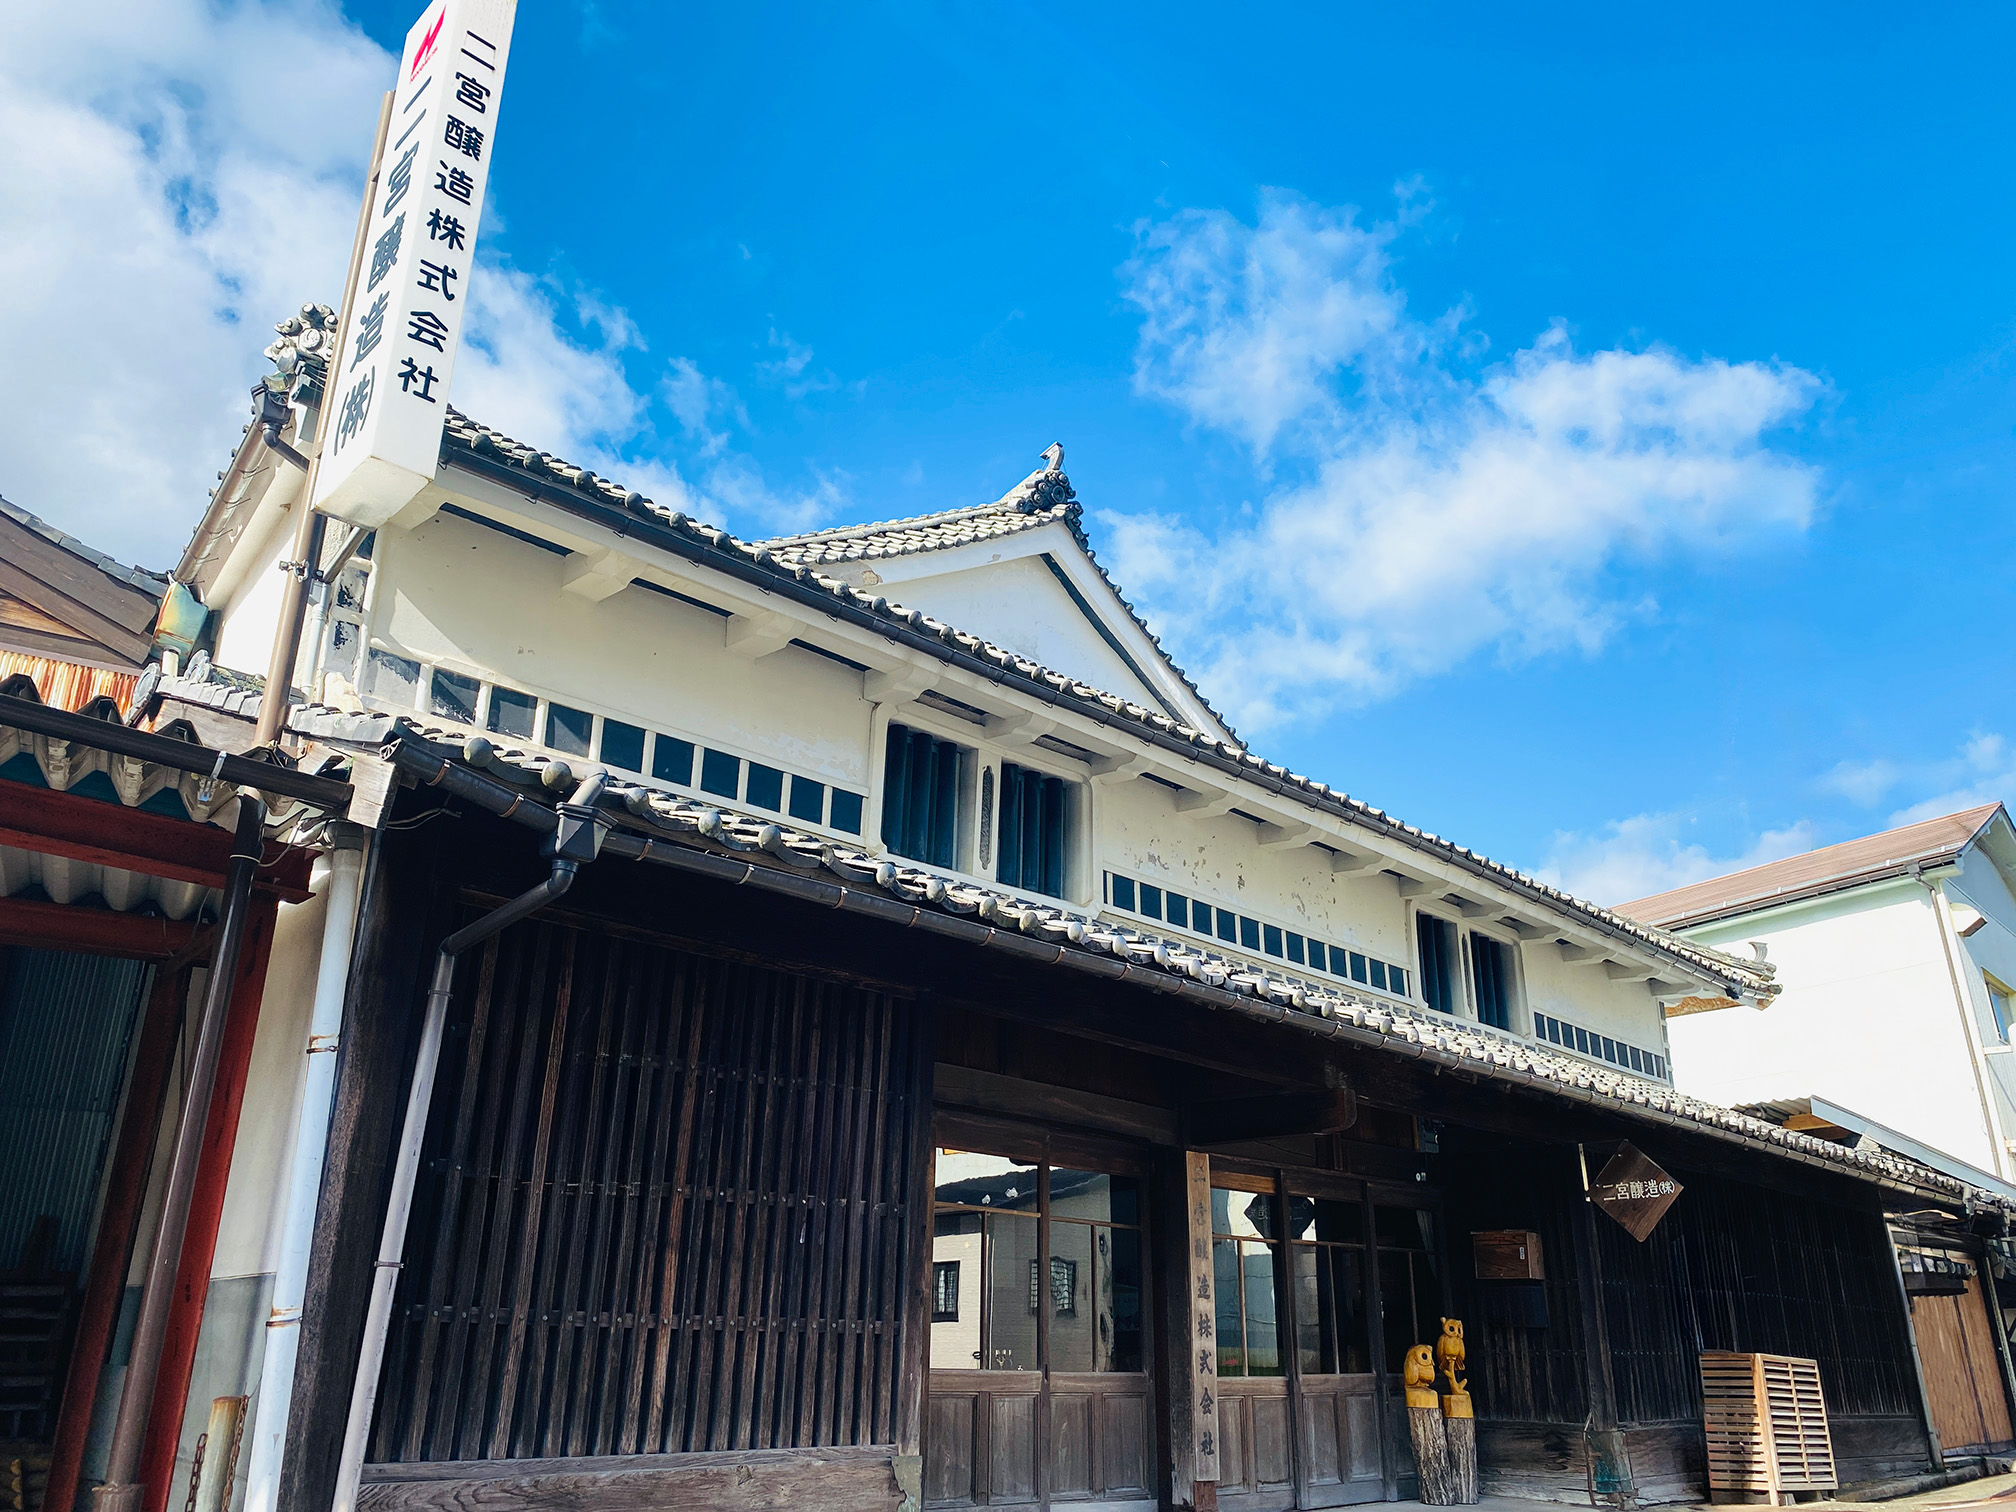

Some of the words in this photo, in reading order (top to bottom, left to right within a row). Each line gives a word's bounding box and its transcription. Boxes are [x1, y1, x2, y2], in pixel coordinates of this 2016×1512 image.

[398, 29, 497, 403] 二宮醸造株式会社
